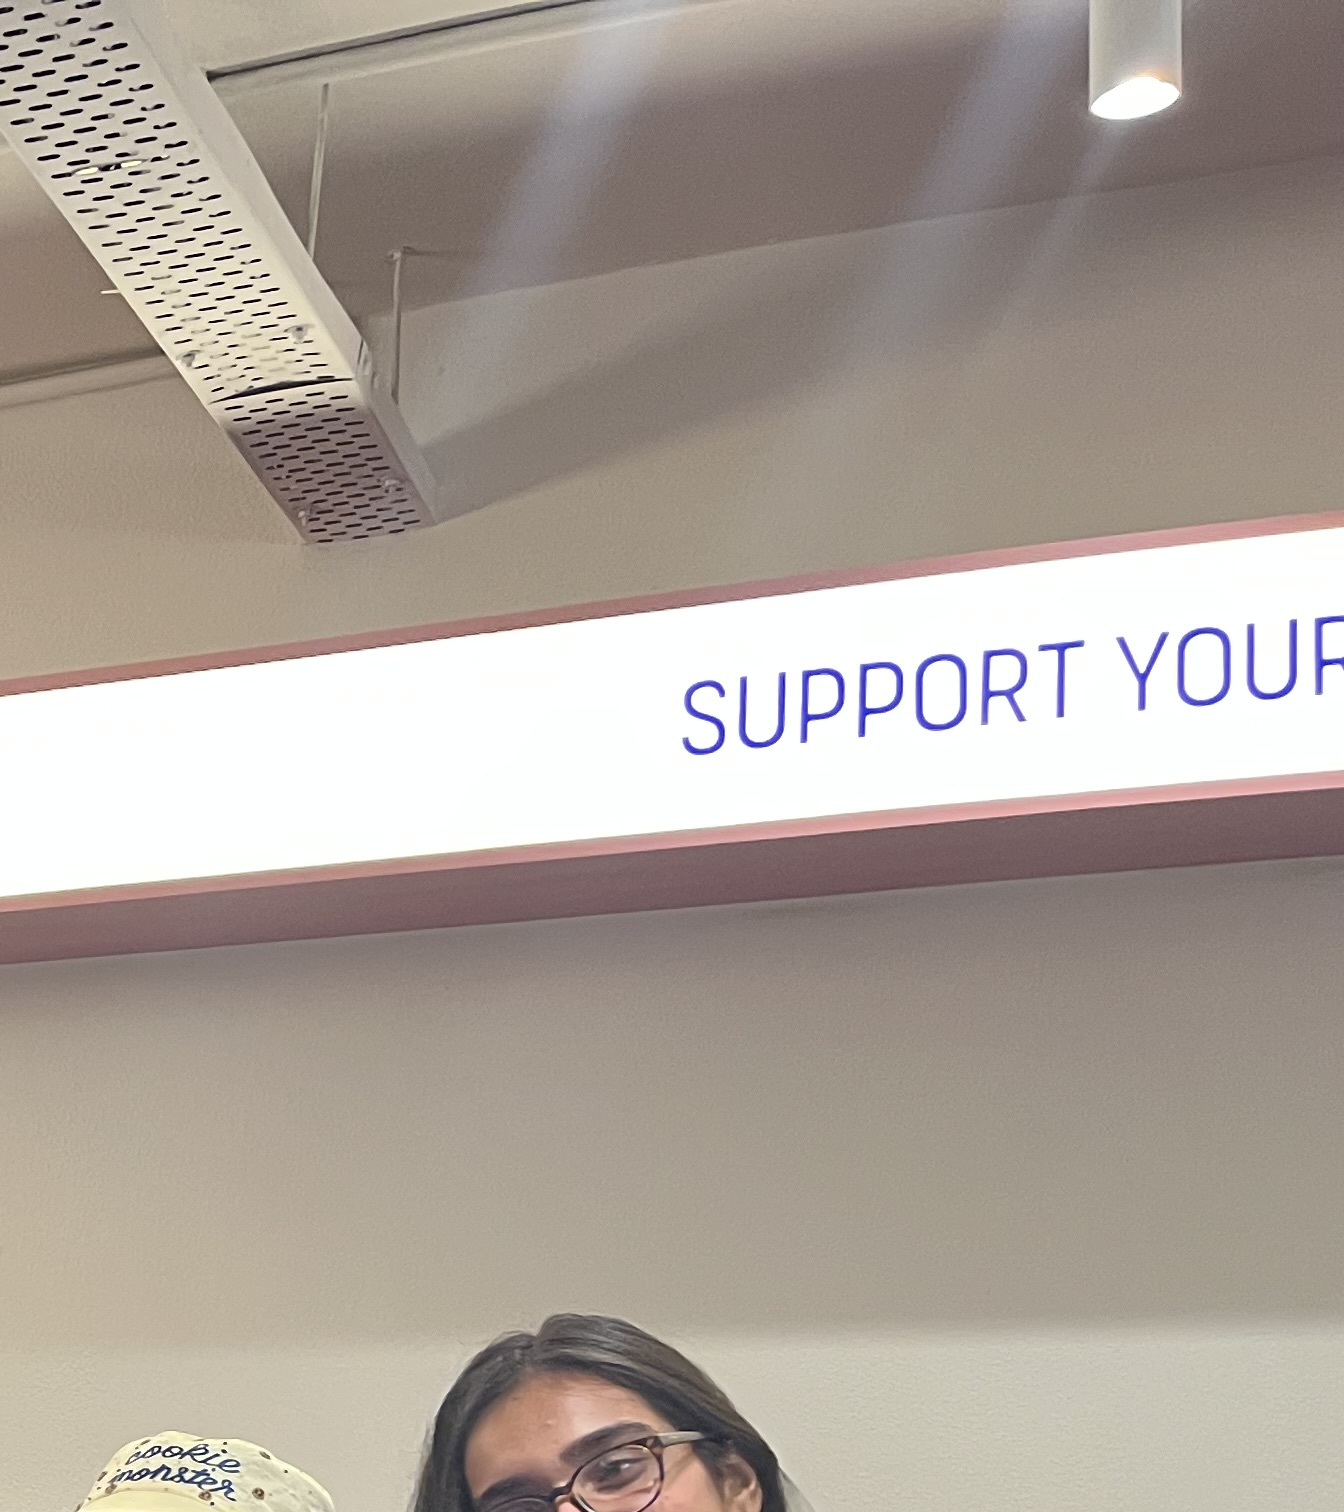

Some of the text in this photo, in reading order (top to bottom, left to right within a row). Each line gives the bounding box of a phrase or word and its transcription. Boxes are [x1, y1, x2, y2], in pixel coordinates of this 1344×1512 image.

[682, 614, 1344, 756] SUPPORT YOUR
[125, 1443, 241, 1473] cookie
[107, 1464, 237, 1501] monster
